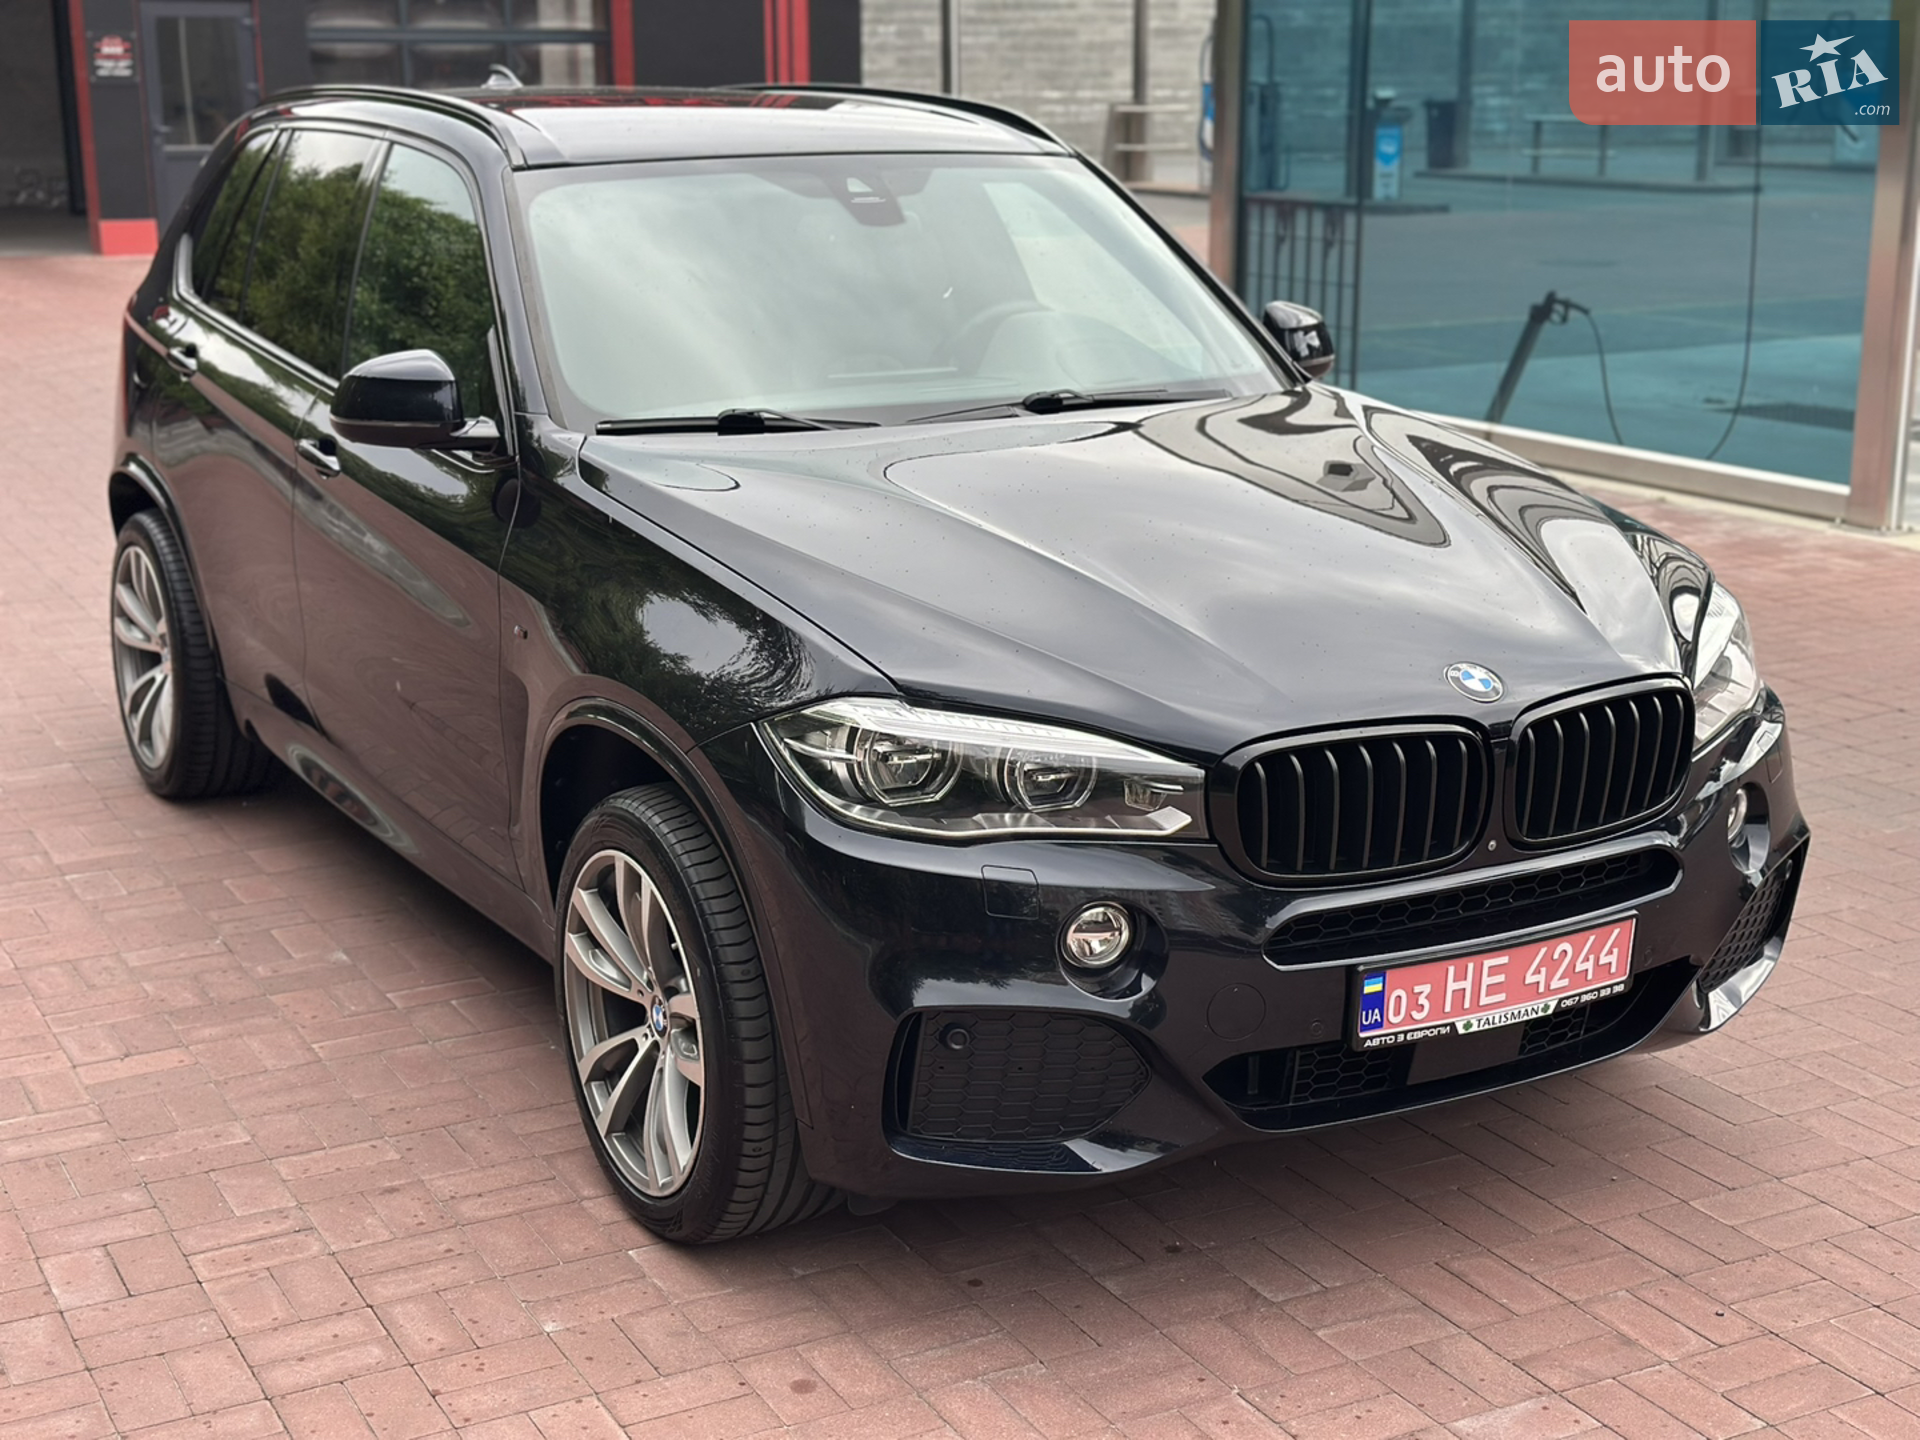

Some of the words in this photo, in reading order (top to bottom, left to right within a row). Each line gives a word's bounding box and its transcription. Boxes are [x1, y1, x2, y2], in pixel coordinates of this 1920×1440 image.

[1387, 983, 1432, 1024] 03
[1444, 955, 1509, 1013] HE
[1524, 927, 1621, 994] 4244
[1362, 1008, 1381, 1025] UA
[1475, 1005, 1540, 1029] TALISMAN
